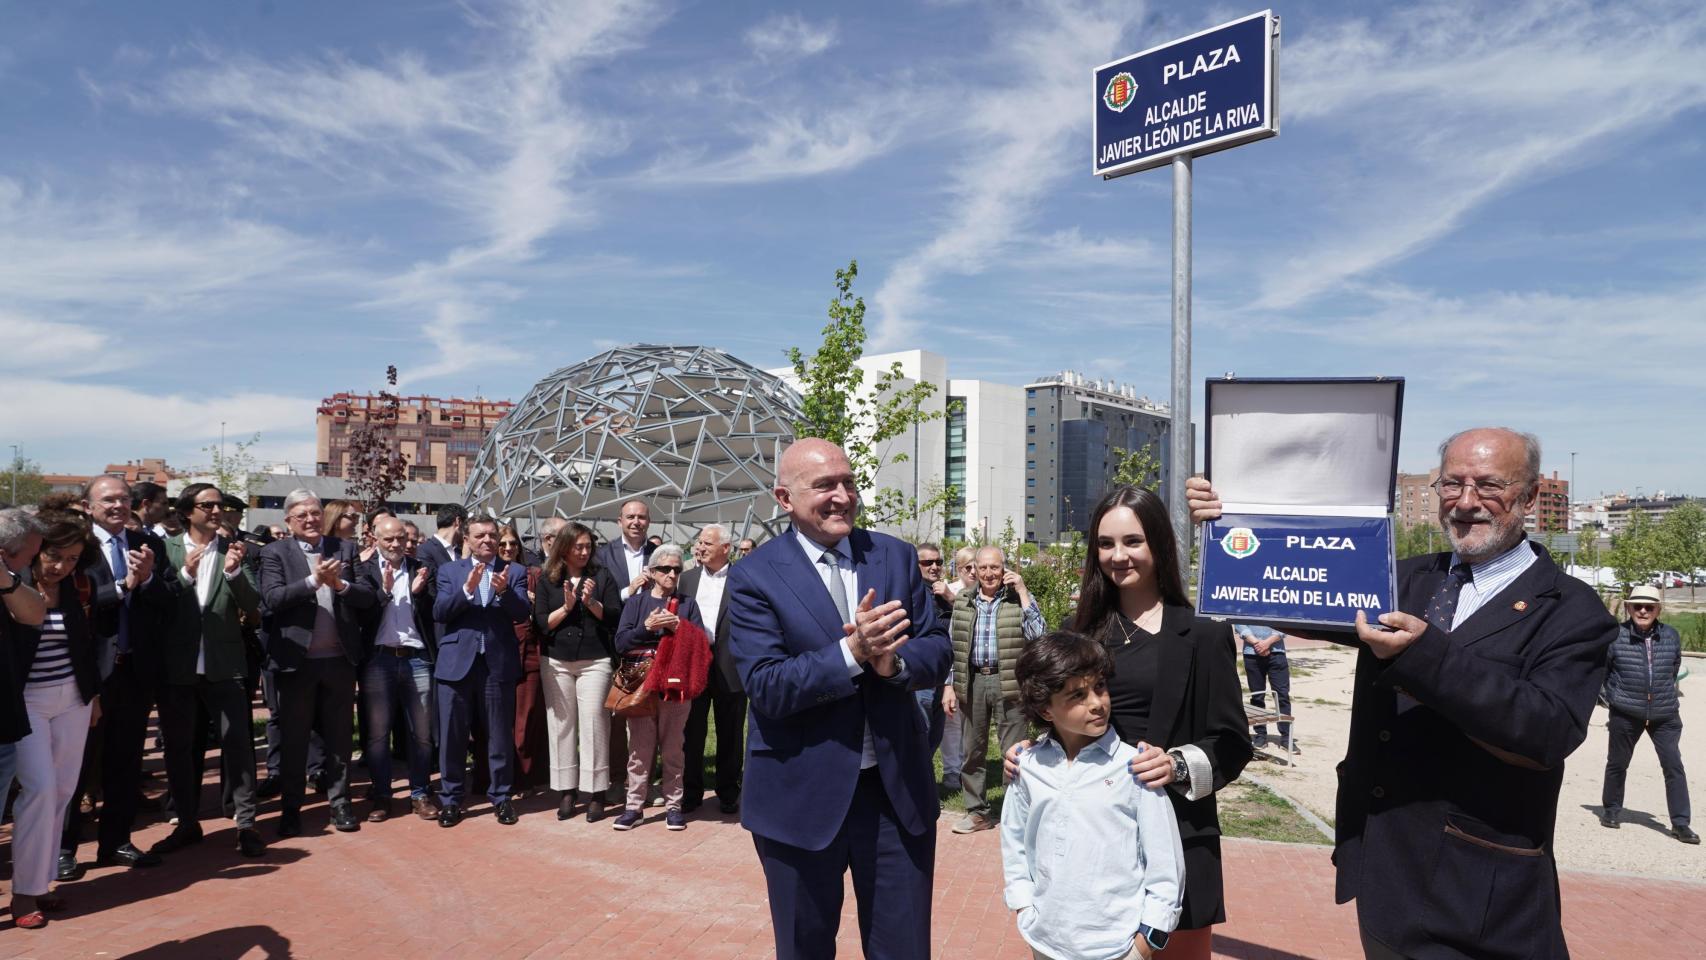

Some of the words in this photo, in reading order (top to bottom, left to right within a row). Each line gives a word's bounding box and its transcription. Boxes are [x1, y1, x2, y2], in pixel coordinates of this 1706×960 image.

[1163, 44, 1241, 85] PLAZA
[1144, 91, 1207, 126] ALCALDE
[1099, 135, 1142, 164] JAVIER
[1145, 124, 1180, 152] LEÓN
[1183, 117, 1202, 141] DE
[1205, 112, 1224, 135] LA
[1226, 102, 1260, 130] RIVA
[1286, 536, 1356, 550] PLAZA
[1263, 565, 1328, 583] ALCALDE
[1211, 585, 1259, 602] JAVIER
[1262, 586, 1300, 604] LEÓN
[1303, 590, 1323, 606] DE
[1326, 591, 1345, 607] LA
[1348, 593, 1381, 609] RIVA
